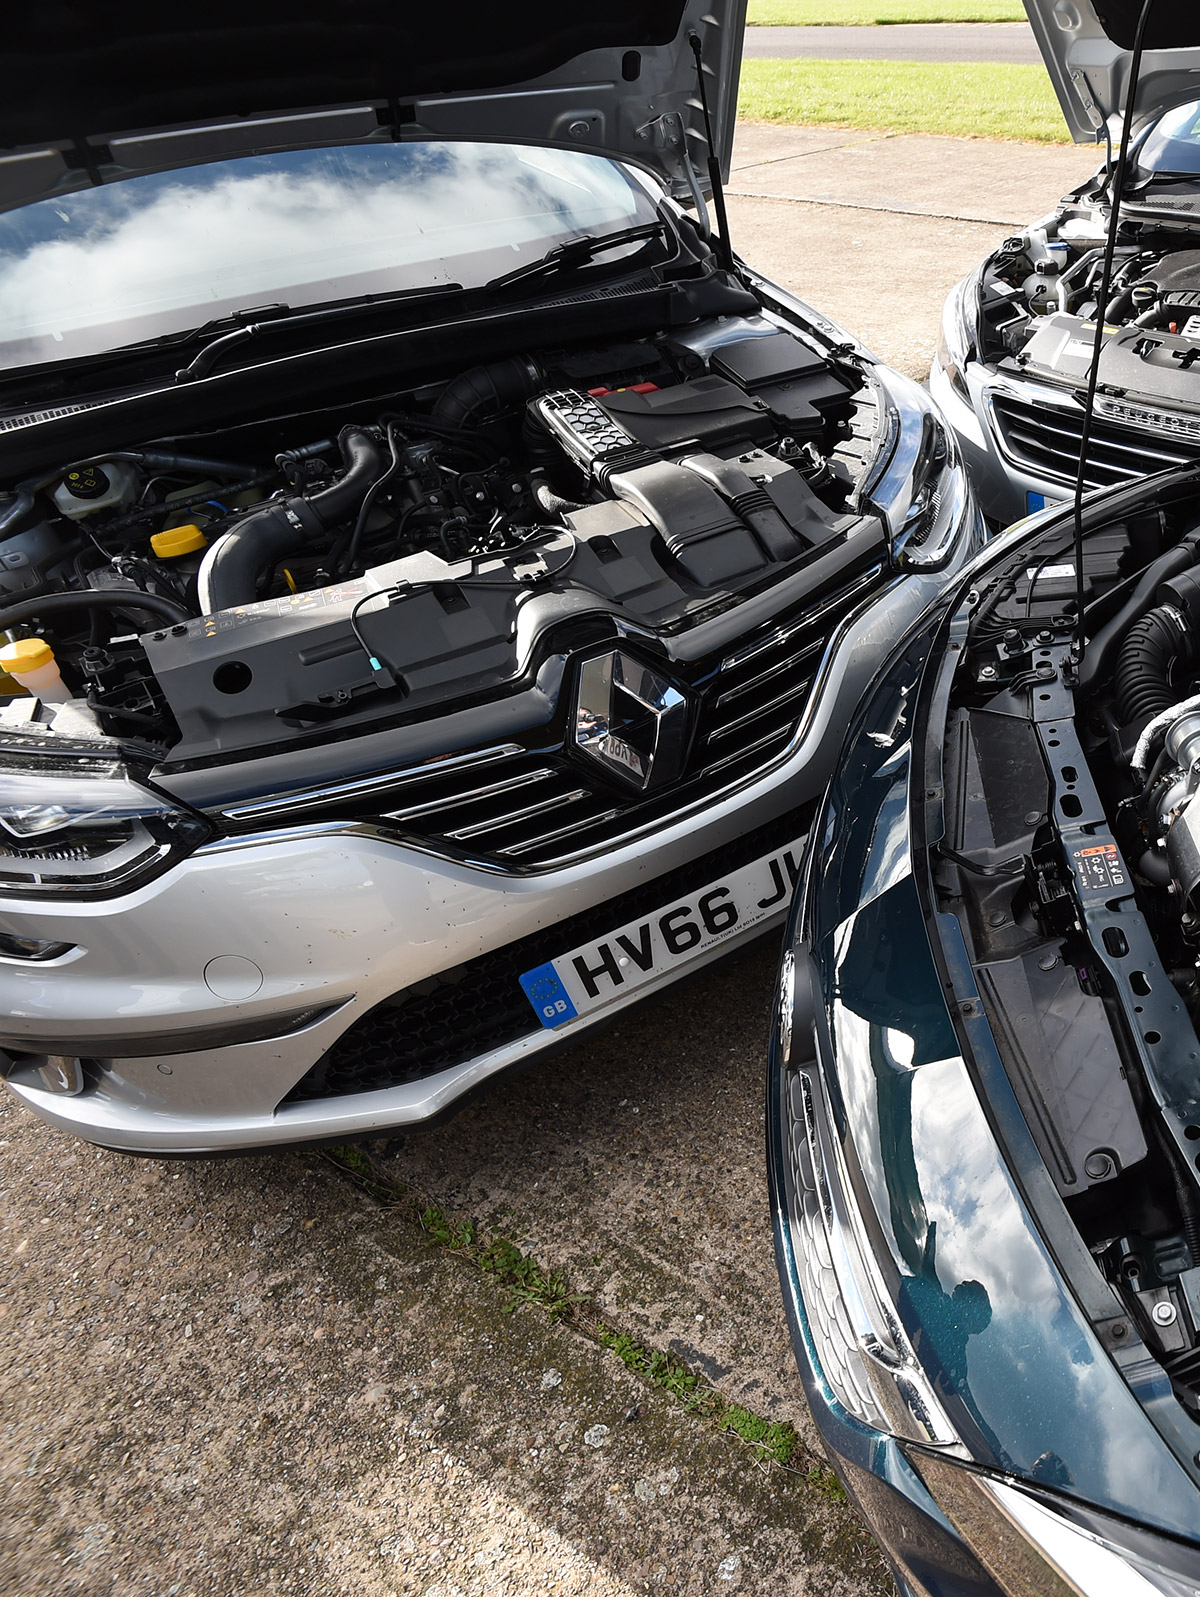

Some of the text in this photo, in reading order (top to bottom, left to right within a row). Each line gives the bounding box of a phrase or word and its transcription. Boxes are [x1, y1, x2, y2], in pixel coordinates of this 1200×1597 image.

[1113, 405, 1192, 427] PEUGEOT
[572, 887, 739, 998] HV66
[543, 1000, 568, 1018] GB
